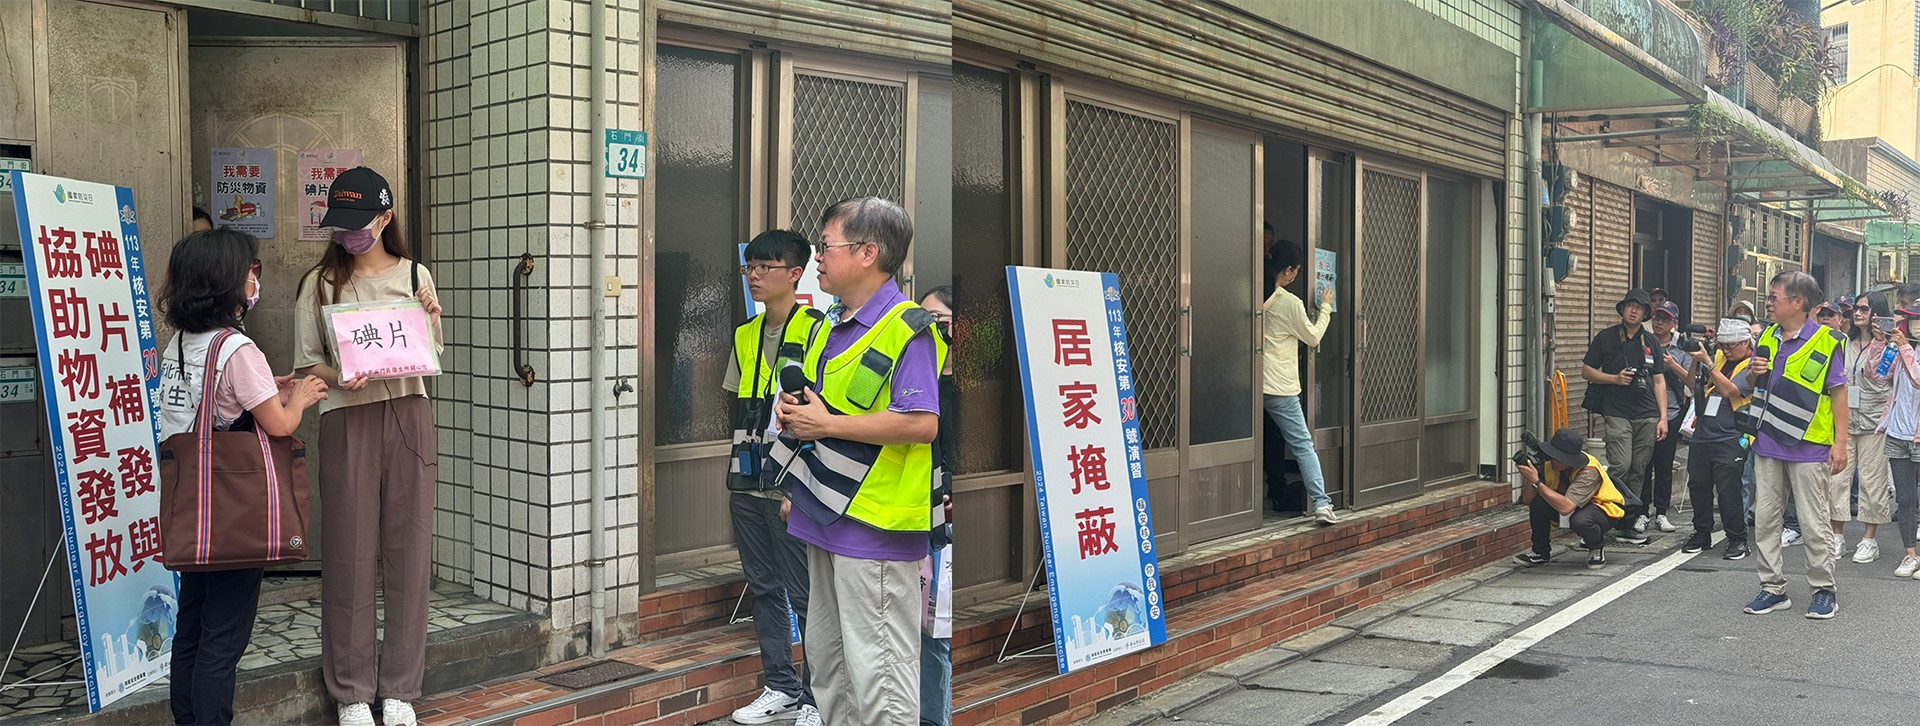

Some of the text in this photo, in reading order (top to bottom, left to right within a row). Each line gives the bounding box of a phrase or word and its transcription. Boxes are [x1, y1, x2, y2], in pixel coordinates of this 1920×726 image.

[0, 161, 27, 169] 門街
[223, 165, 261, 178] 我需要
[617, 147, 639, 173] 34
[216, 182, 267, 194] 防災物資
[0, 280, 16, 294] 34
[351, 320, 407, 350] 碘片
[1, 384, 19, 399] 34
[82, 231, 163, 574] 碘片補發與
[38, 225, 127, 587] 協助物資發放
[1051, 318, 1119, 560] 居家掩蔽
[55, 445, 97, 705] 2024 Taiwan Nuclear Emergency Exercise
[1036, 470, 1066, 669] 2024 Taiwan Nuclear Emergency Exercise
